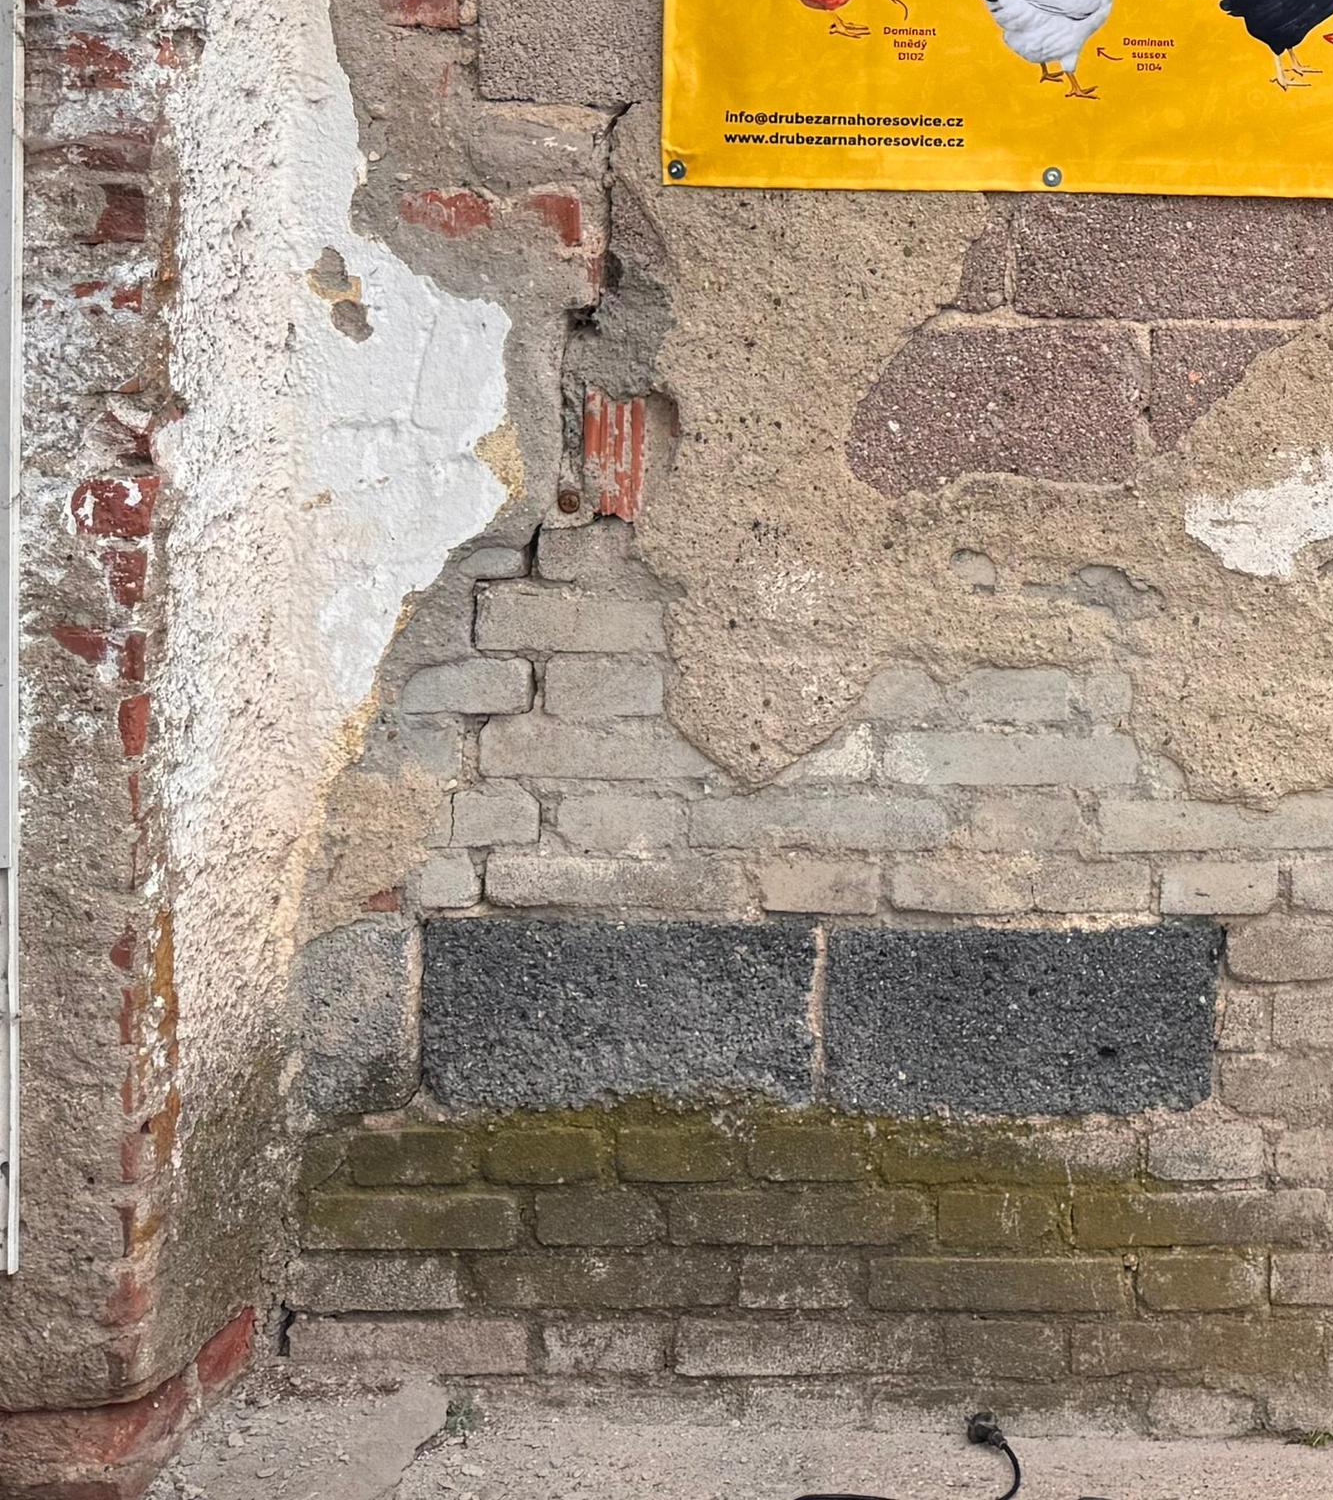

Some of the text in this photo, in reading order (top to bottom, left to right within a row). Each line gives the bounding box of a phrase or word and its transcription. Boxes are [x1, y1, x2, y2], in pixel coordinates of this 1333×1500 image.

[883, 26, 937, 36] Dominant
[893, 38, 928, 50] hnědý
[1122, 37, 1175, 47] Dominant
[898, 52, 925, 61] D102
[1136, 62, 1162, 72] D104
[725, 110, 965, 128] info@drubezarnahoresovice.cz
[724, 132, 965, 148] www.drubezarnahoresovice.cz
